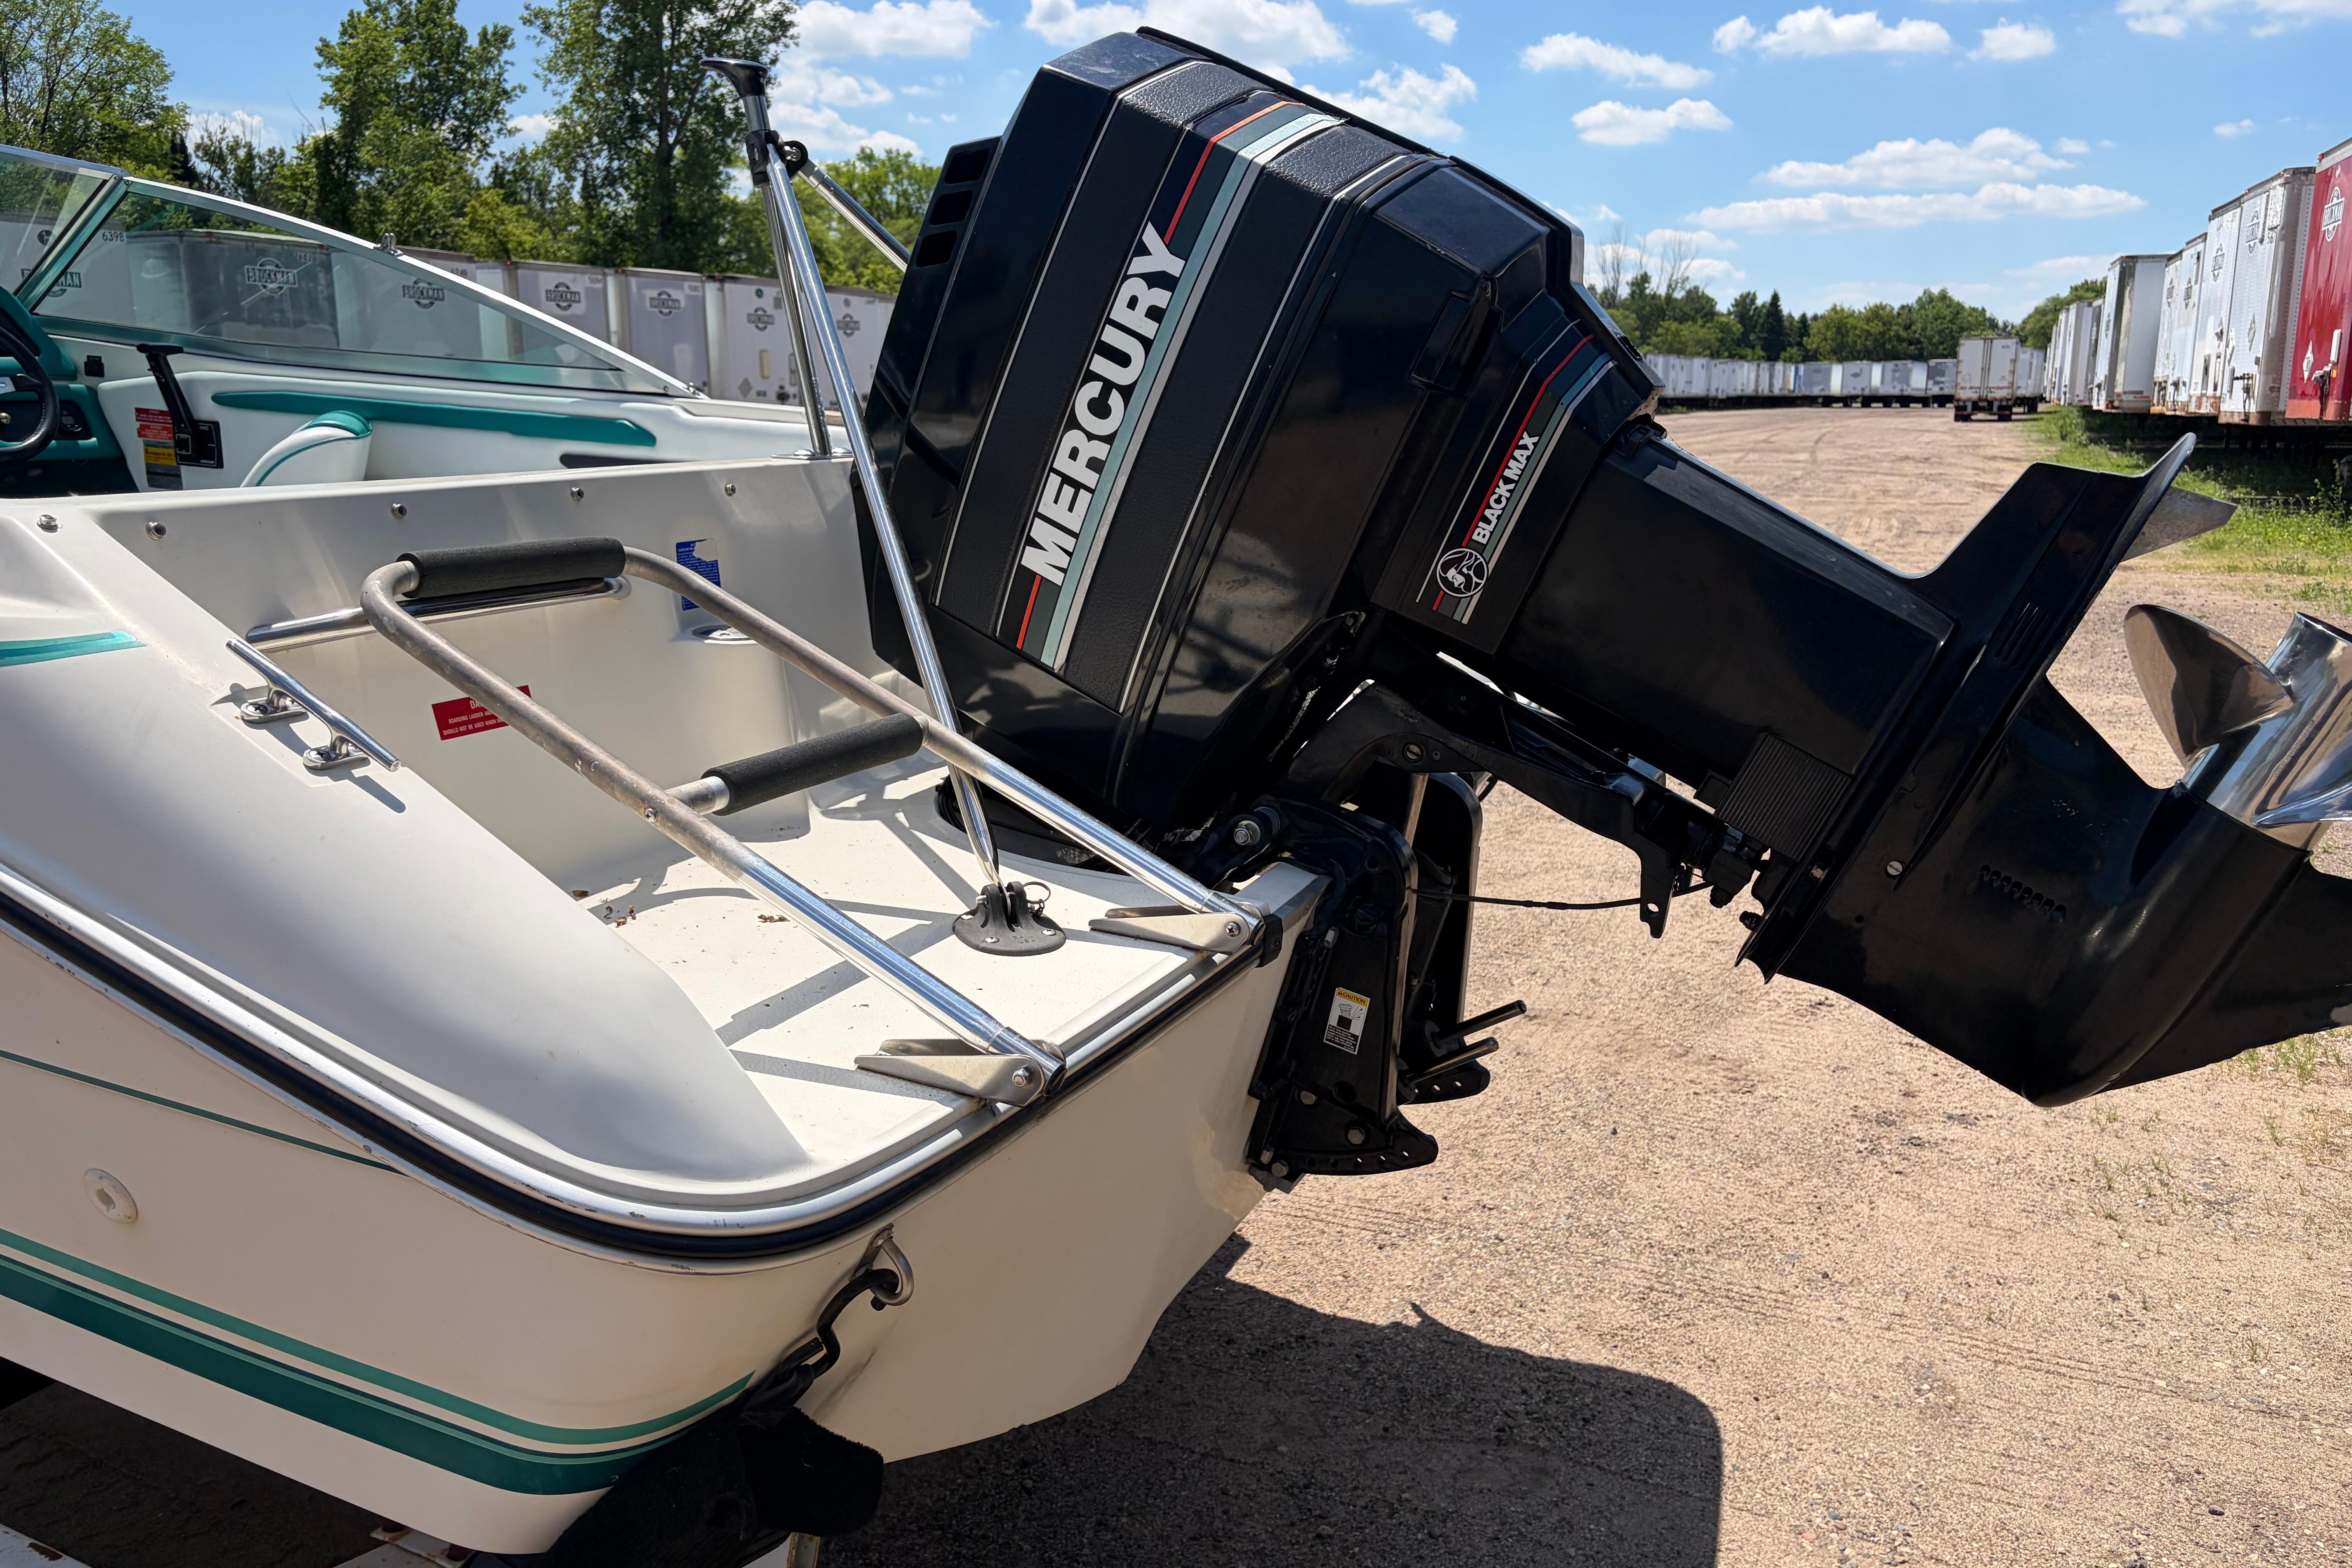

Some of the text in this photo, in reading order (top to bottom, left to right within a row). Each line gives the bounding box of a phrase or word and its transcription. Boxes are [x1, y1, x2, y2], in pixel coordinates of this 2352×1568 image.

[102, 231, 124, 242] 6398
[1020, 220, 1185, 586] MERCURY
[1472, 431, 1539, 544] BLACK MAX
[448, 715, 468, 724] BOARDING
[443, 727, 458, 735] SHOULD
[1342, 992, 1365, 1004] CAUTION
